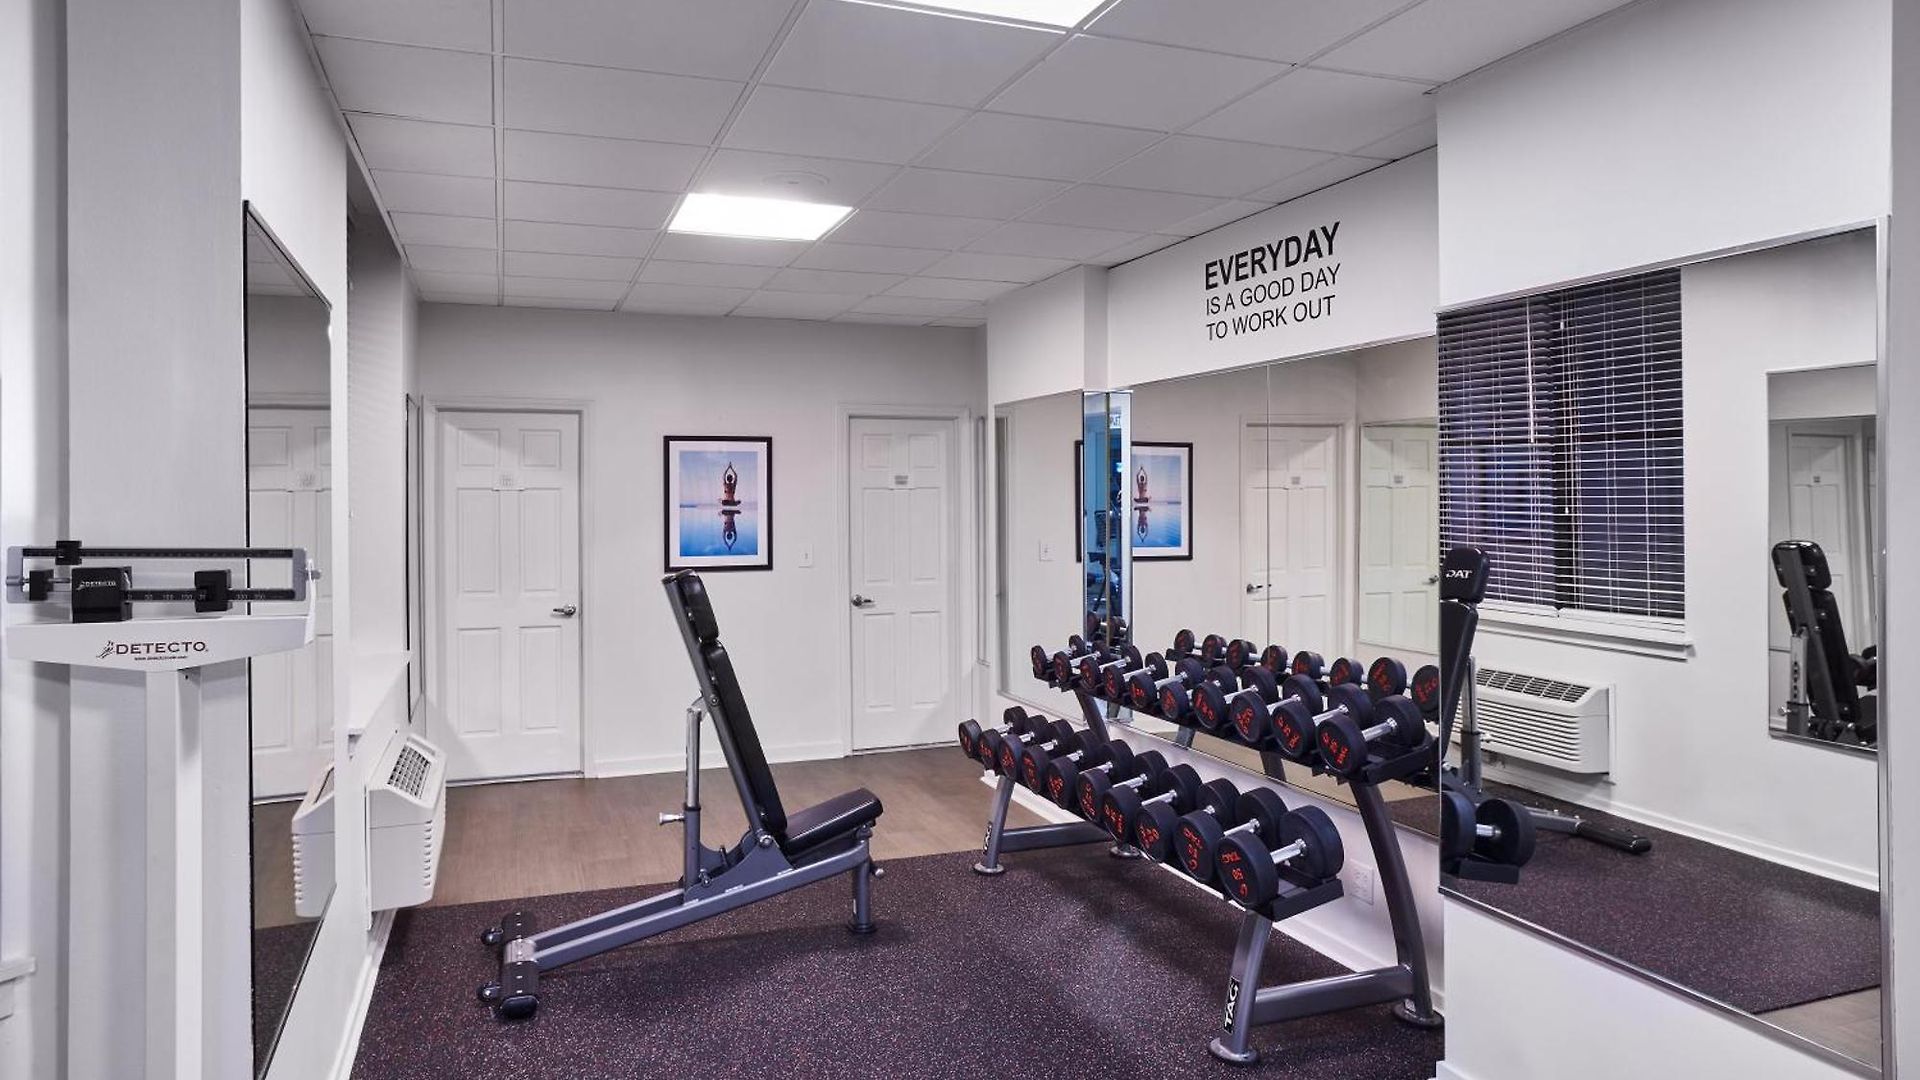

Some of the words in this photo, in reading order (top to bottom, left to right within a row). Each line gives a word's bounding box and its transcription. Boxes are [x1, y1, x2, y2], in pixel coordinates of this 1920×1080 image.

[1205, 221, 1340, 290] EVERYDAY
[1206, 296, 1220, 316] IS
[1224, 293, 1235, 312] A
[1240, 277, 1294, 307] GOOD
[1301, 263, 1340, 292] DAY
[1206, 320, 1228, 340] TO
[1232, 306, 1287, 335] WORK
[1293, 295, 1335, 322] OUT
[116, 641, 206, 654] DETECTO
